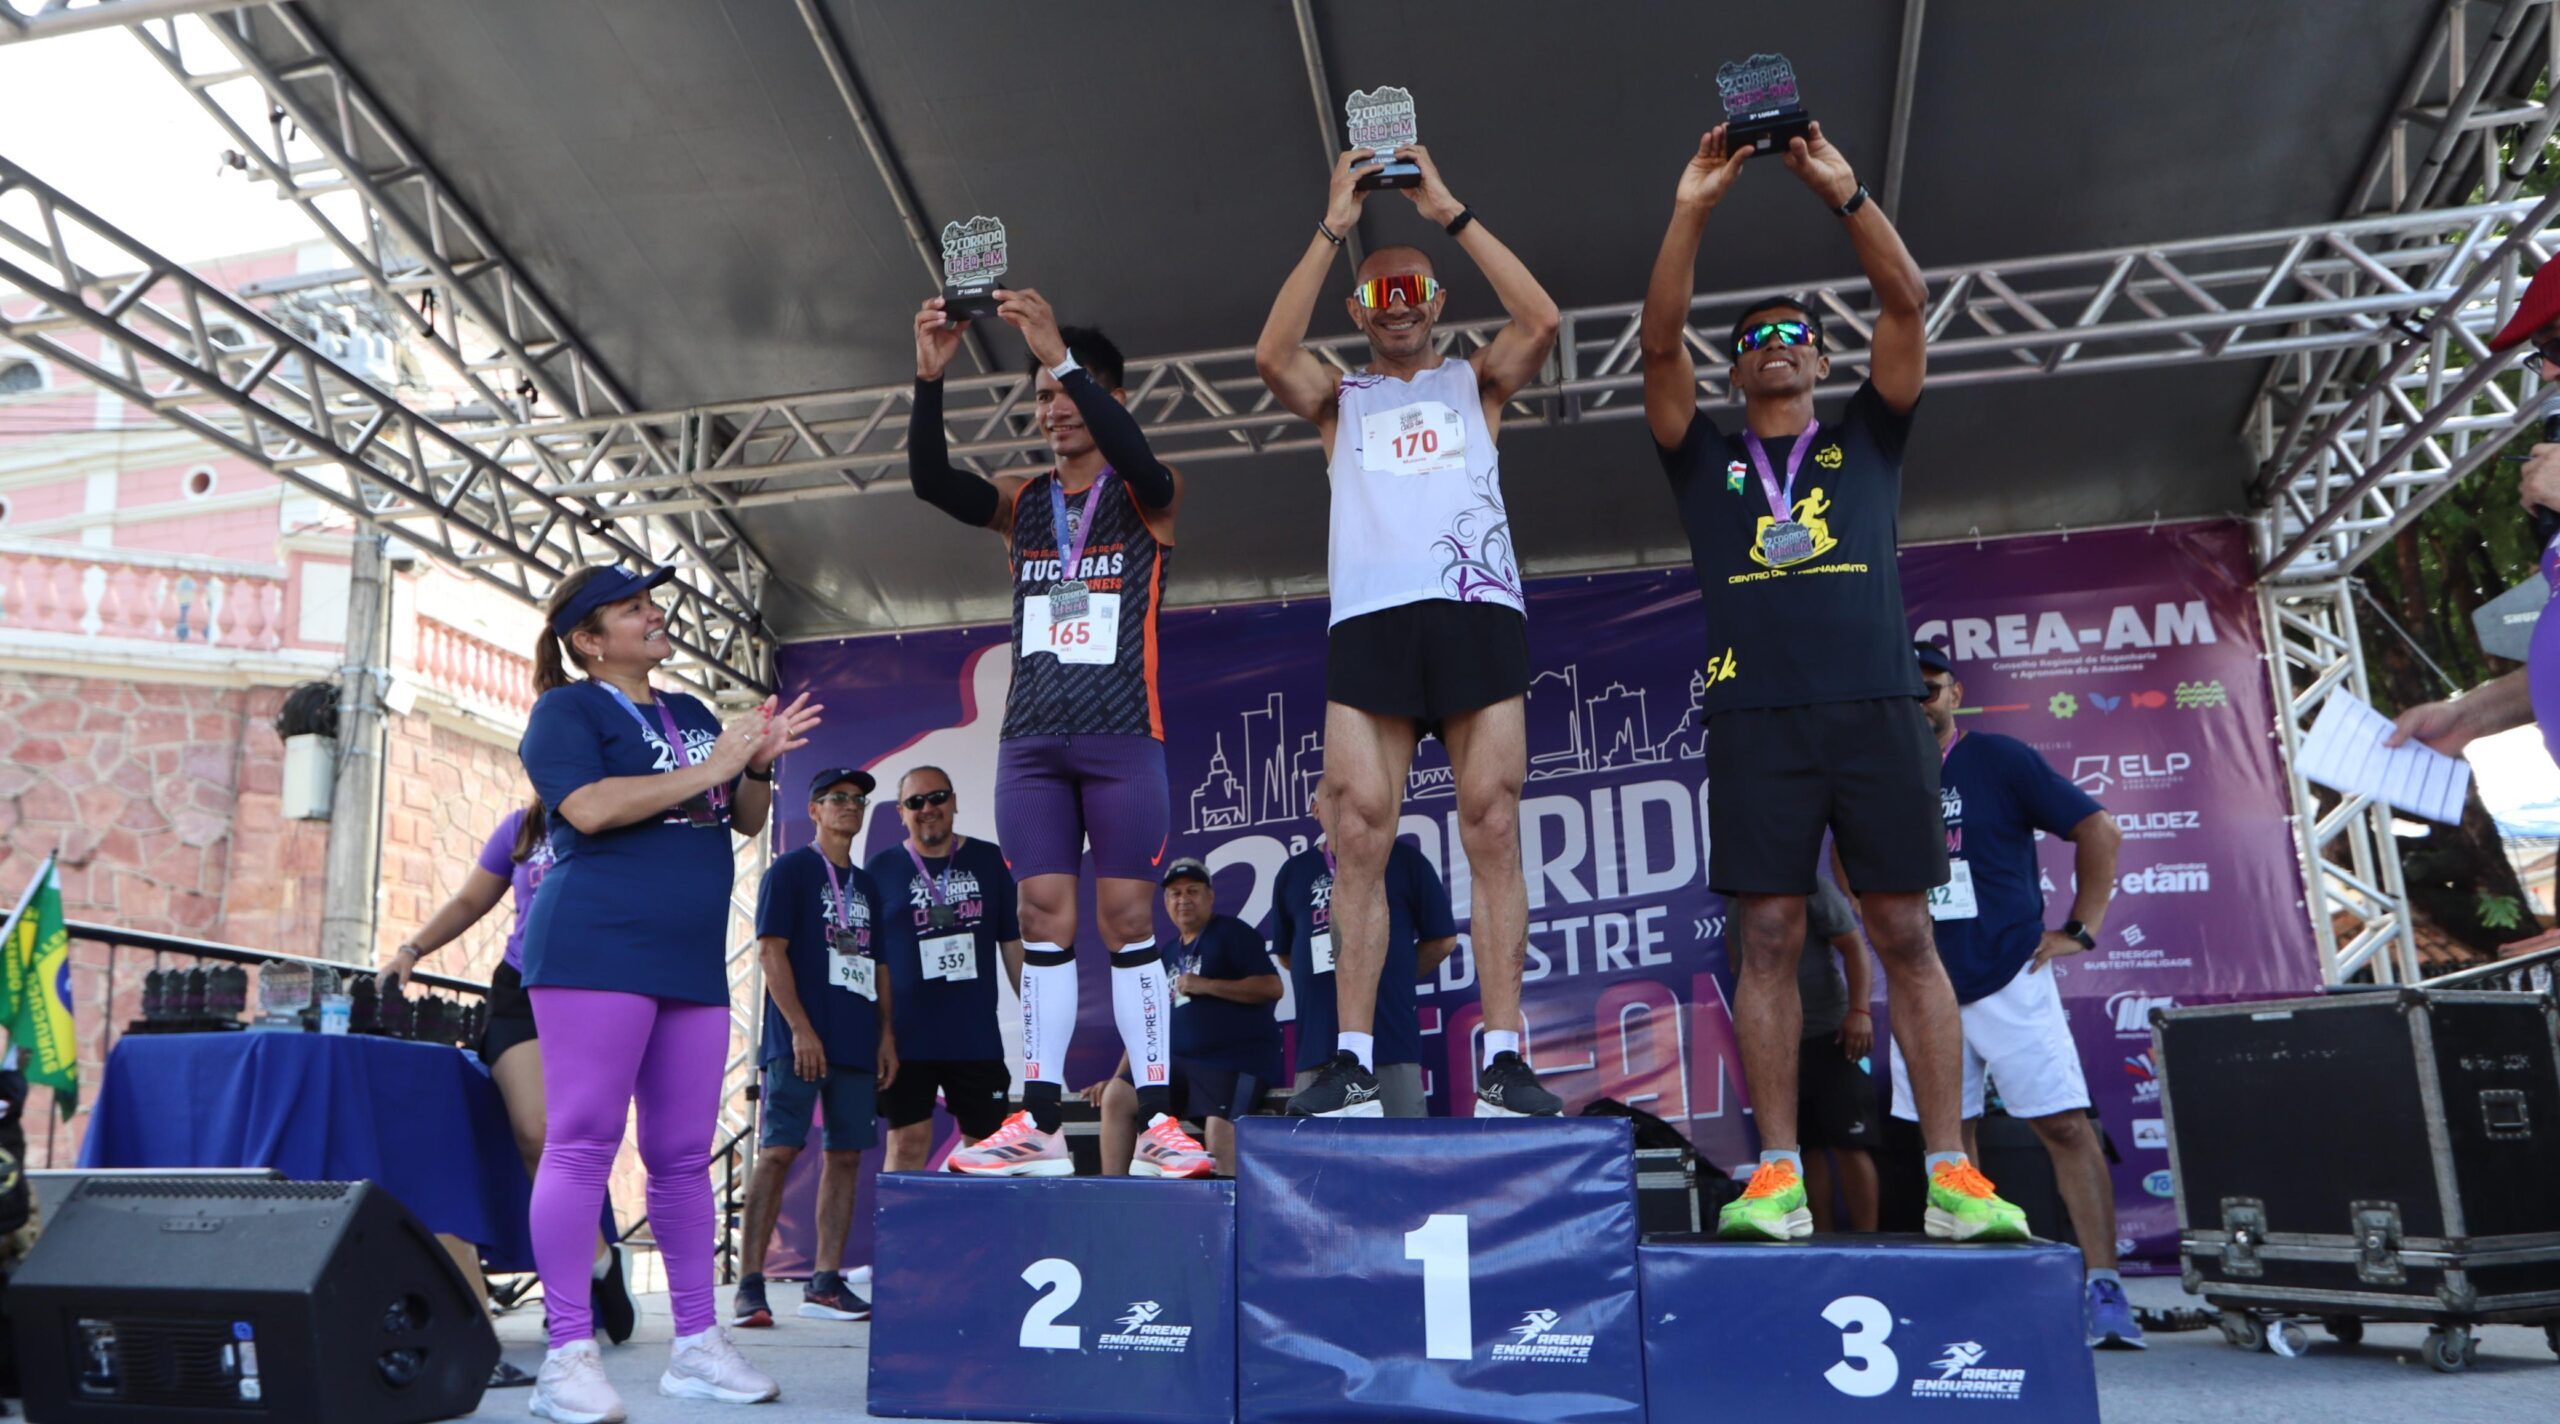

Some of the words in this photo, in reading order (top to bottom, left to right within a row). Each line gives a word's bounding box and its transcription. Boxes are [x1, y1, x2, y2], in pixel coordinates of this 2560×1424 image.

[1362, 101, 1412, 119] CORRIDA
[957, 230, 1002, 251] CORRIDA
[947, 248, 1004, 274] CREA-AM
[1392, 429, 1438, 459] 170
[1774, 529, 1808, 544] CORRIDA
[1728, 571, 1770, 584] CENTRO
[1048, 621, 1091, 646] 165
[1914, 600, 2218, 663] CREA-AM
[1992, 660, 2037, 671] Conselho
[2039, 656, 2082, 669] Regional
[2084, 655, 2097, 663] de
[2100, 651, 2157, 664] Engenharia
[2019, 667, 2074, 679] Agronomia
[2091, 662, 2144, 673] Amazonas
[2118, 752, 2191, 777] ELP
[2112, 811, 2200, 831] OLIDEZ
[2121, 867, 2210, 894] etam
[937, 952, 966, 971] 339
[2084, 957, 2192, 970] SUSTENTABILIDADE
[841, 966, 865, 985] 949
[1404, 1214, 1472, 1360] 1
[1019, 1258, 1082, 1349] 2
[1140, 1324, 1192, 1336] ARENA
[1099, 1333, 1188, 1347] ENDURANCE
[1537, 1334, 1594, 1346] ARENA
[1823, 1295, 1899, 1397] 3
[1492, 1344, 1591, 1357] ENDURANCE
[1961, 1368, 2026, 1381] ARENA
[1912, 1379, 2022, 1393] ENDURANCE
